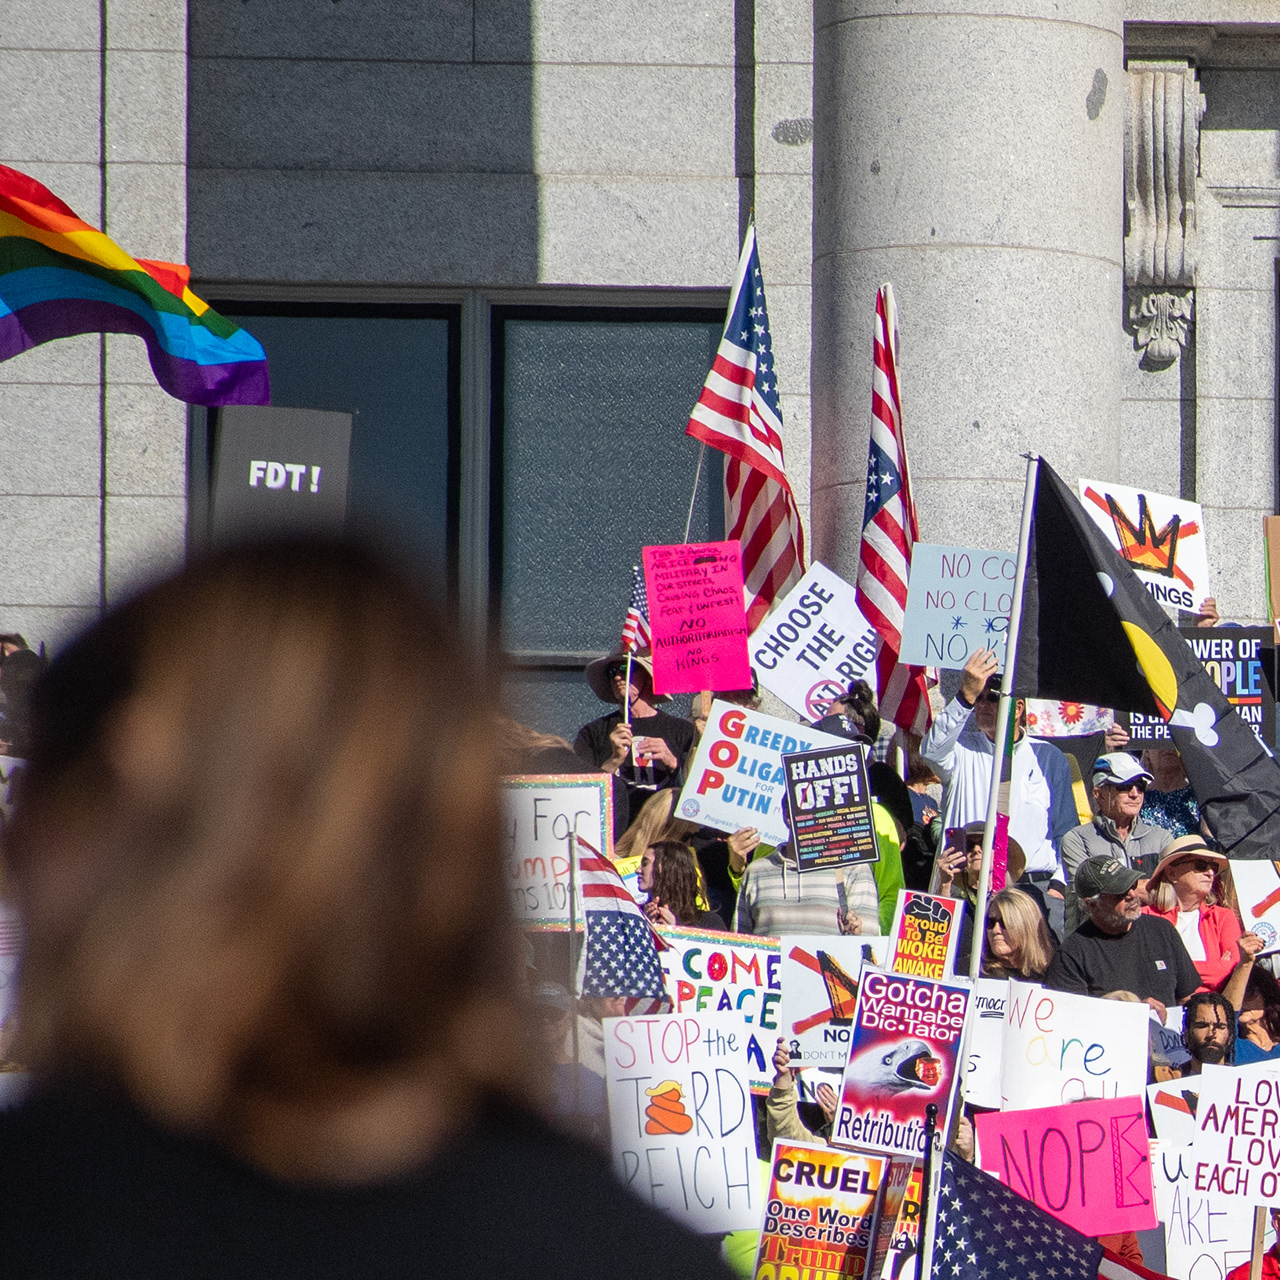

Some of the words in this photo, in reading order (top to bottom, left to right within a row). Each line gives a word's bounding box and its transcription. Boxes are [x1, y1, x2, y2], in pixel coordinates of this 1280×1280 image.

[249, 460, 321, 493] FDT!
[754, 582, 834, 670] CHOOSE
[676, 654, 719, 671] KINGS
[796, 623, 845, 671] THE
[790, 754, 858, 780] HANDS
[697, 769, 772, 815] PUTIN
[795, 775, 859, 810] OFF!
[905, 914, 948, 933] Proud
[905, 927, 922, 940] To
[925, 931, 943, 944] Be
[897, 939, 947, 960] WOKE!
[682, 947, 781, 991] COME
[861, 971, 967, 1015] Gotcha
[860, 996, 964, 1029] Wannabe
[614, 1018, 700, 1069] STOP
[702, 1028, 739, 1057] the
[773, 1158, 879, 1196] CRUEL
[1194, 1162, 1249, 1196] EACH
[763, 1216, 870, 1247] Describes
[766, 1199, 810, 1221] One
[818, 1207, 873, 1231] Word
[761, 1235, 866, 1276] Trump
